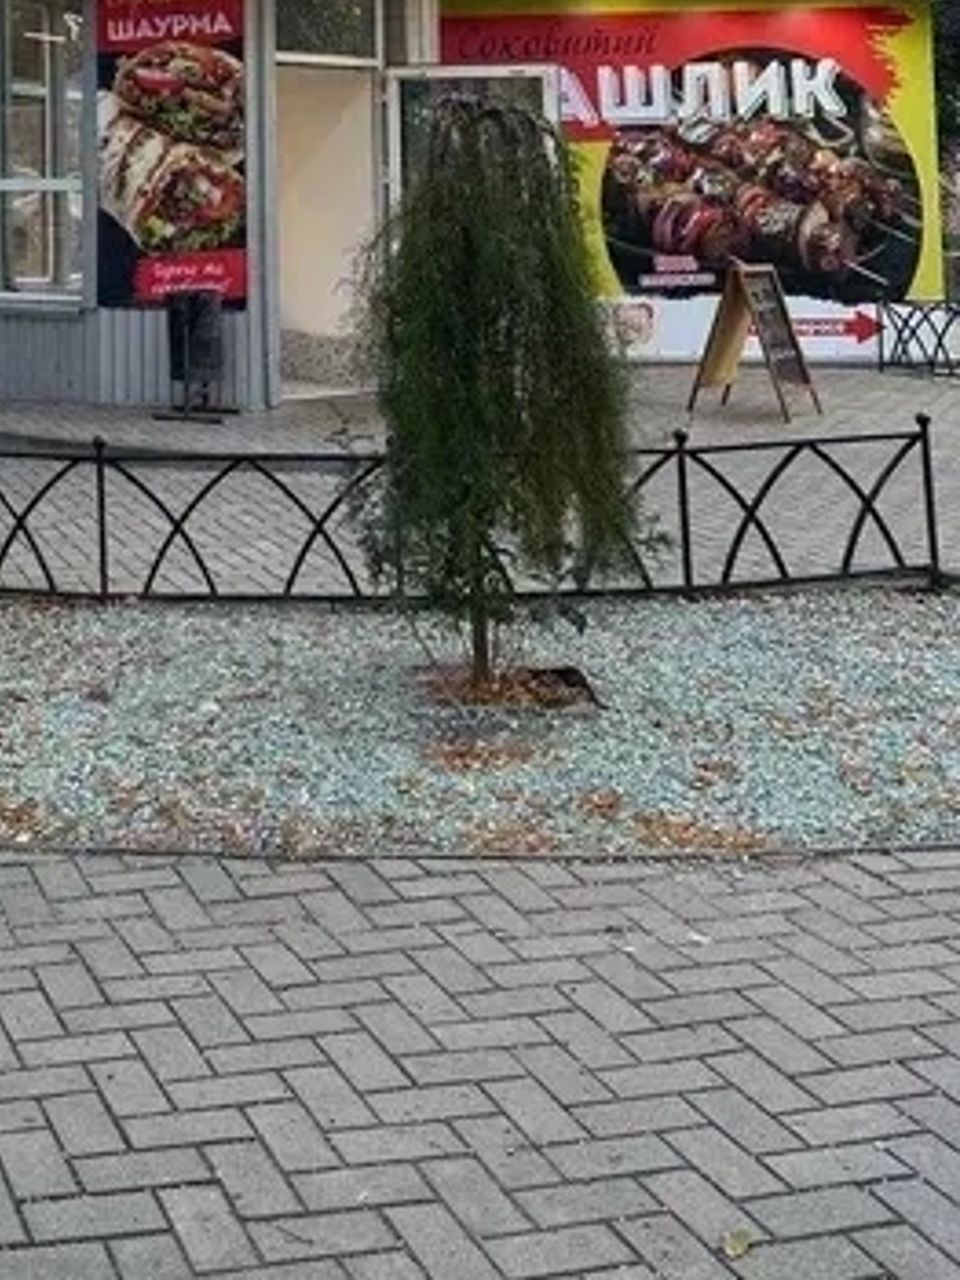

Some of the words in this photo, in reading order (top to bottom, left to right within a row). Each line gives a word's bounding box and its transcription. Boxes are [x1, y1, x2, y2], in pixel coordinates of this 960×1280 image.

[106, 10, 234, 41] ШАУРМА
[458, 22, 659, 61] Соковитий
[559, 56, 848, 128] АШЛИК
